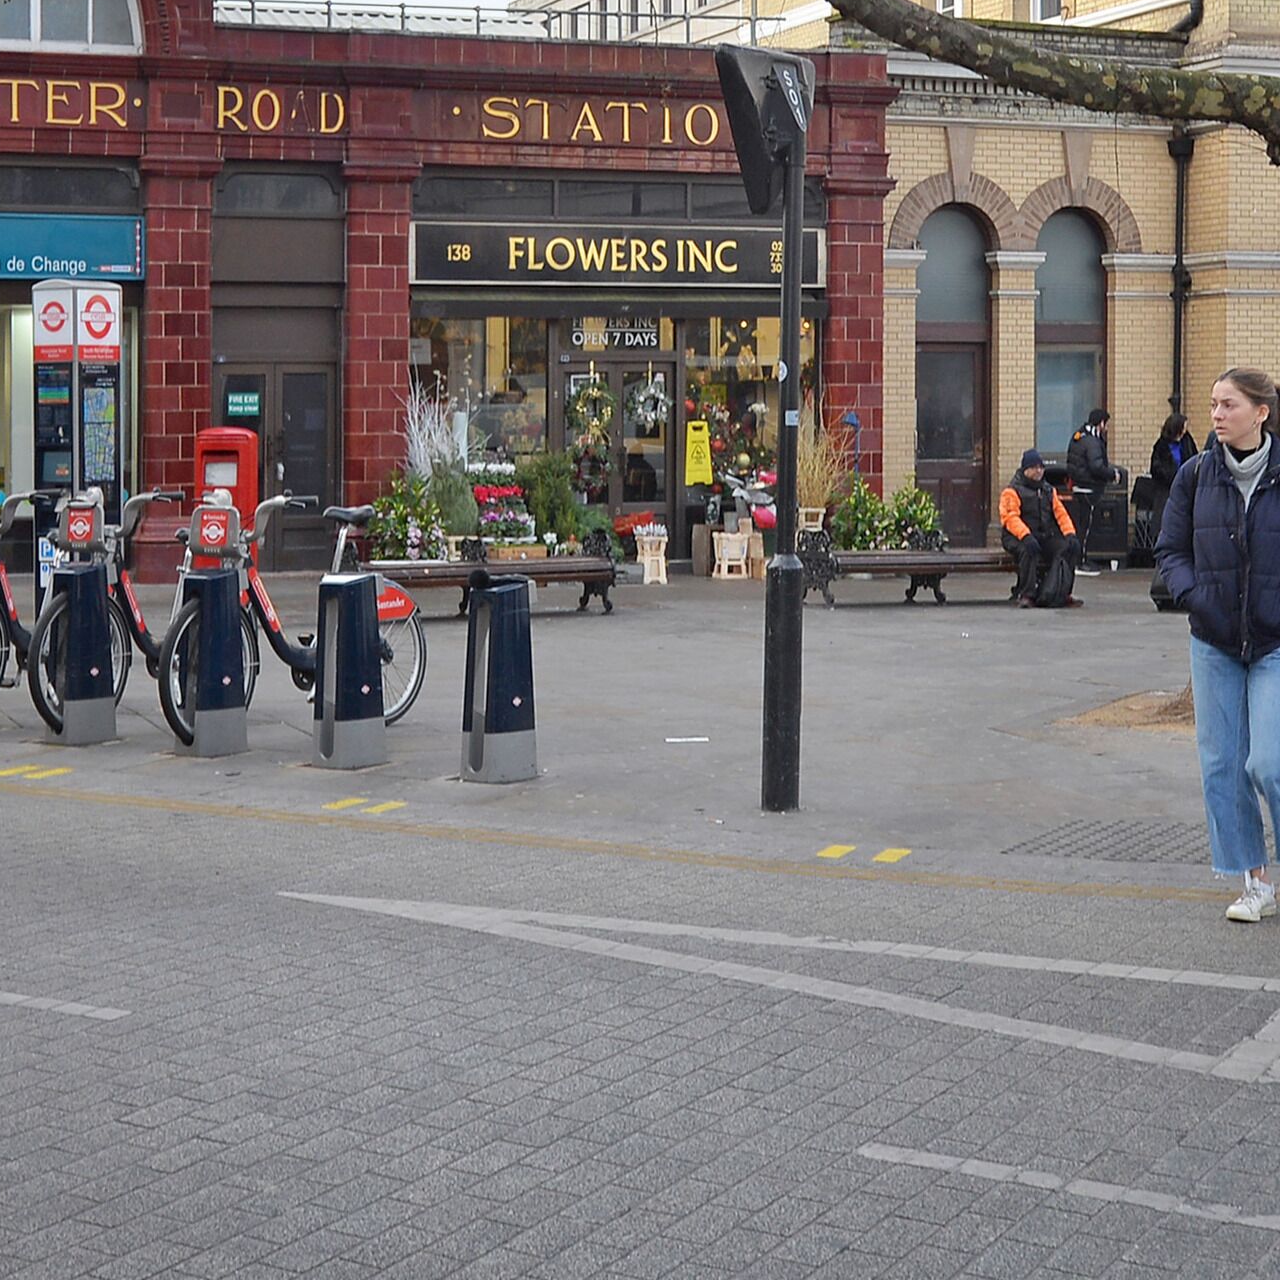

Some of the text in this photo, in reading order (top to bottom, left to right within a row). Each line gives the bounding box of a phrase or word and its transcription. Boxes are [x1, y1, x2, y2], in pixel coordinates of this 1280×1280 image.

[482, 96, 719, 145] STATIO
[771, 240, 783, 252] 02
[447, 236, 739, 274] 138 FLOWERS INC
[770, 251, 783, 262] 73
[7, 256, 25, 272] de
[31, 256, 87, 275] Change
[770, 262, 782, 274] 30
[572, 331, 658, 347] OPEN 7 DAYS
